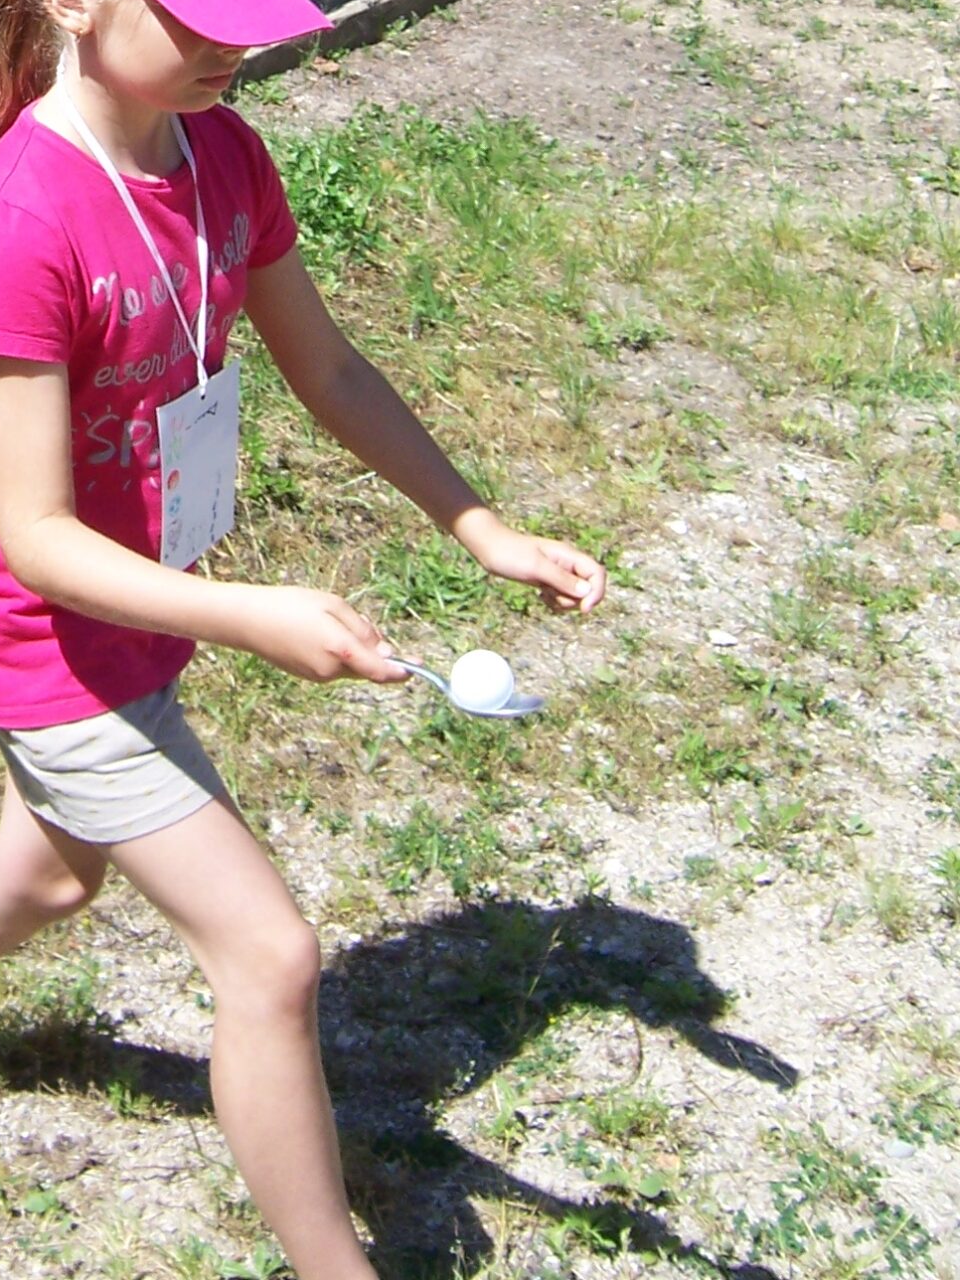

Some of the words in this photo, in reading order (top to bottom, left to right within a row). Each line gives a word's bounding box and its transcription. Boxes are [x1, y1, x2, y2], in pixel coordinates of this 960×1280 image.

[92, 271, 145, 326] No
[151, 262, 189, 307] oe
[94, 352, 166, 388] ever
[86, 414, 161, 467] SP
